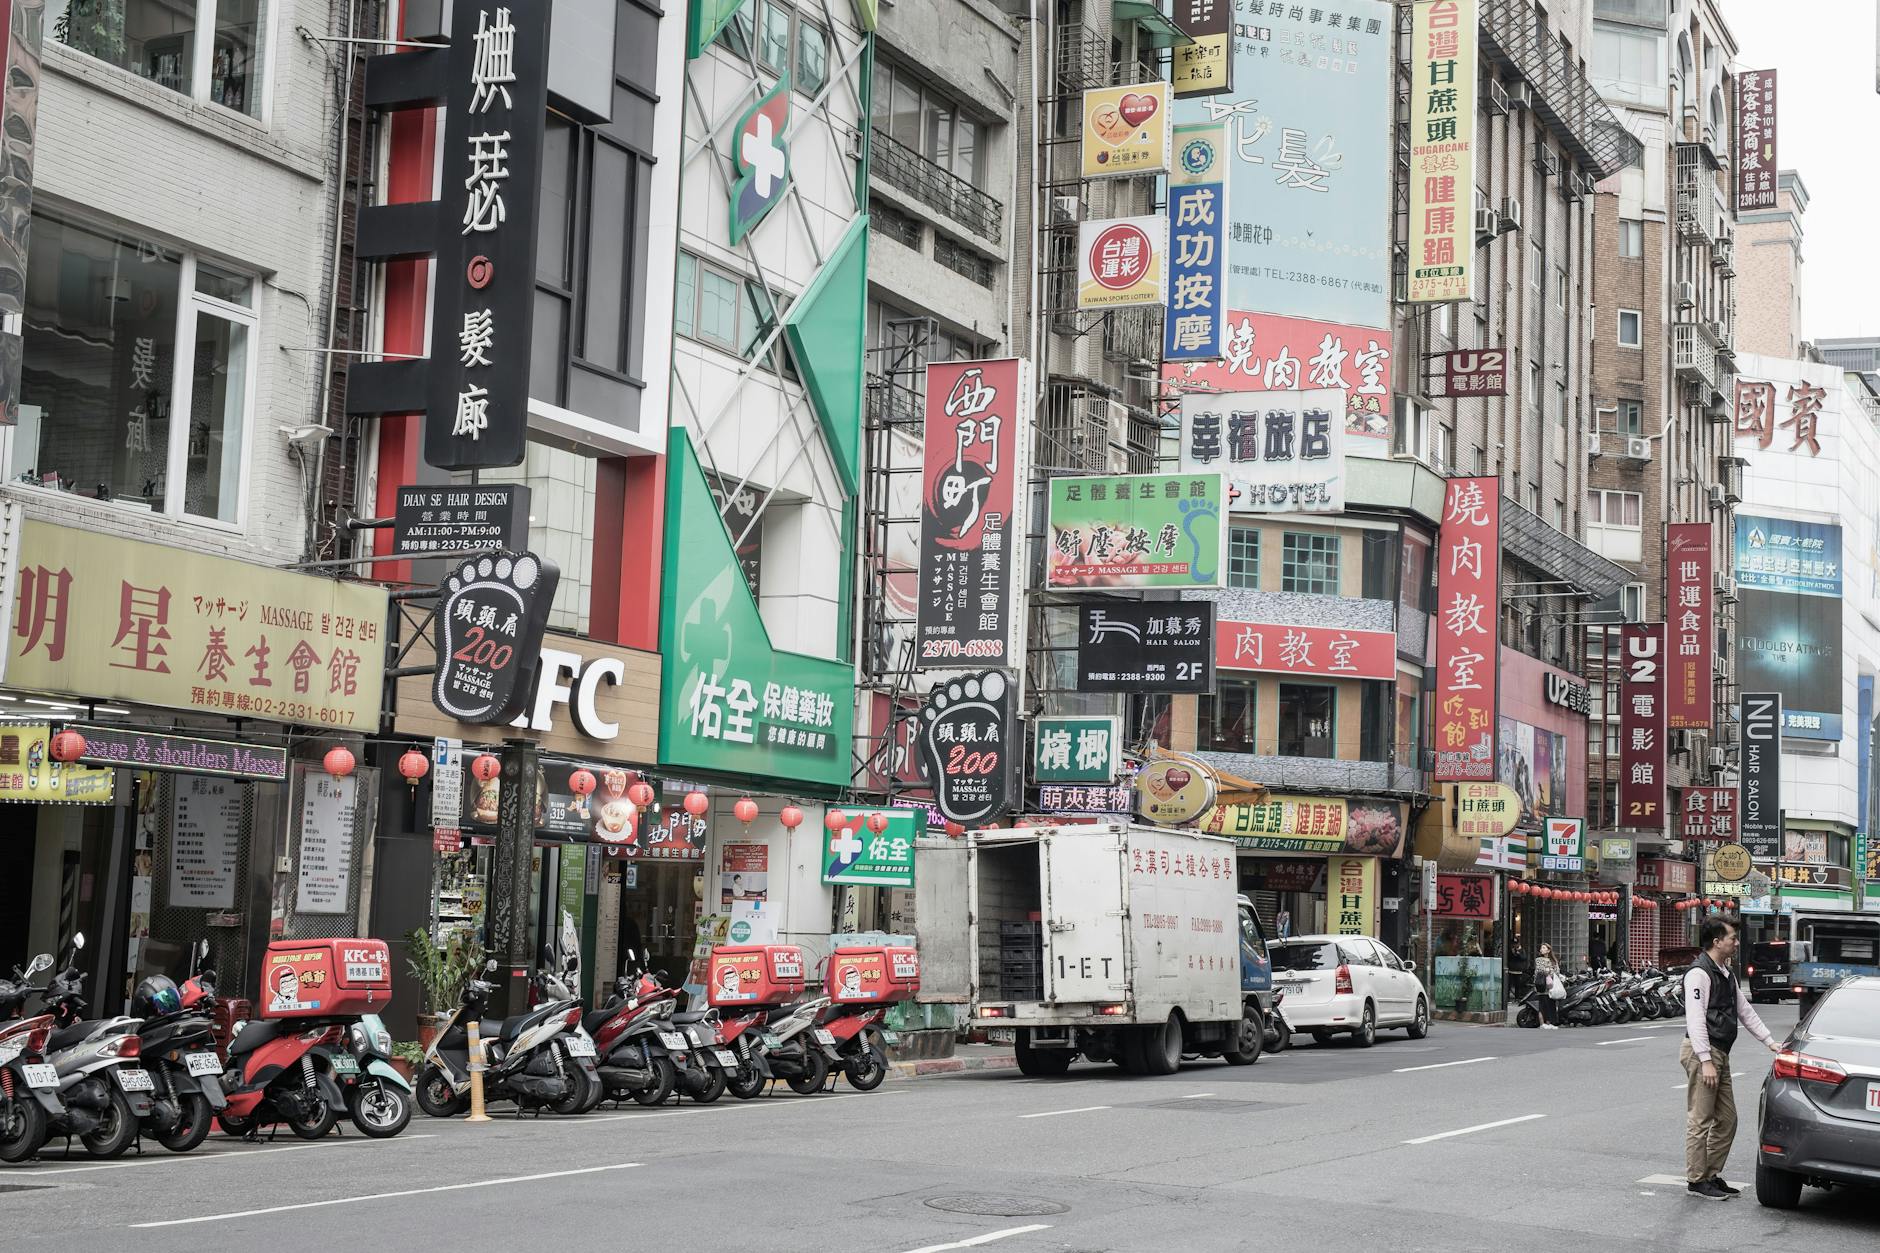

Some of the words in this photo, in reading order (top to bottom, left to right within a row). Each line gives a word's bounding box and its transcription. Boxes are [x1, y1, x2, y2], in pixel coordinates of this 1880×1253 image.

[1425, 58, 1459, 143] 甘蔗頭
[1741, 73, 1762, 170] 愛客發商旅
[1412, 141, 1470, 156] SUGARCANE
[1740, 191, 1775, 207] 2361-1010
[1423, 175, 1457, 266] 健康鍋
[1172, 189, 1217, 352] 成功按摩
[1412, 276, 1468, 291] 2375-4711
[1084, 295, 1107, 304] TAIWAN
[1108, 294, 1130, 302] SPORTS
[1131, 292, 1155, 301] LOTTERY
[1217, 317, 1390, 395] 燒肉教室
[1452, 352, 1503, 373] U2
[452, 308, 494, 441] 髮廊
[1452, 373, 1503, 391] 電影館
[1735, 378, 1827, 458] 國賓
[1191, 407, 1332, 464] 幸福旅店
[943, 368, 1002, 539] 西門町
[403, 493, 426, 507] DIAN
[430, 493, 442, 506] SE
[447, 493, 469, 506] HAIR
[474, 492, 508, 506] DESIGN
[1066, 480, 1206, 502] 足體養生會館
[1250, 482, 1332, 505] HOTEL
[421, 510, 487, 522] 營業時間
[932, 554, 943, 607] マッサージ
[978, 512, 1003, 631] 足體養生會館
[1055, 566, 1095, 575] マッサージ
[1098, 565, 1138, 574] MASSAGE
[944, 553, 957, 622] MASSAGE
[1443, 480, 1491, 692] 燒肉教室
[12, 565, 173, 674] 明星
[193, 595, 249, 622] マッサージ
[260, 604, 314, 632] MASSAGE
[321, 612, 331, 635] 발
[358, 620, 377, 644] 센터
[1678, 560, 1702, 656] 世運食品
[1146, 616, 1202, 636] 加慕秀
[452, 626, 513, 670] 200
[922, 639, 1003, 657] 2370-6888
[1629, 636, 1658, 682] U2
[1757, 638, 1794, 652] DOLBY
[197, 624, 361, 697] 養生會館
[458, 663, 494, 680] マッサージ
[1176, 662, 1203, 681] 2F
[454, 671, 492, 689] MASSAGE
[509, 648, 625, 741] FC
[191, 686, 355, 726] 預約專線:02-2331-6017
[689, 671, 759, 744] 佑全
[762, 681, 834, 728] 保健藥妝
[1746, 700, 1774, 740] NU
[767, 726, 826, 750] 您健康的顧問
[1039, 728, 1108, 771] 檳榔
[1631, 694, 1655, 785] 電影館
[85, 739, 129, 762] ssage
[132, 737, 150, 762] &
[154, 740, 228, 770] shoulders
[946, 745, 998, 774] 200
[1748, 744, 1760, 773] HAIR
[1461, 798, 1506, 813] 甘蔗頭
[1468, 784, 1499, 798] 台灣
[1747, 779, 1760, 821] SALON
[1295, 803, 1343, 837] 健康鍋
[1630, 802, 1657, 816] 2F
[1462, 820, 1504, 834] 健康鍋
[1552, 823, 1576, 856] 7
[868, 836, 910, 861] 佑全
[1260, 837, 1304, 850] 2375-4711
[1753, 845, 1769, 855] 2F
[343, 949, 368, 963] KFC
[773, 952, 790, 963] KFC
[892, 954, 907, 964] KFC
[1693, 988, 1701, 1000] 3
